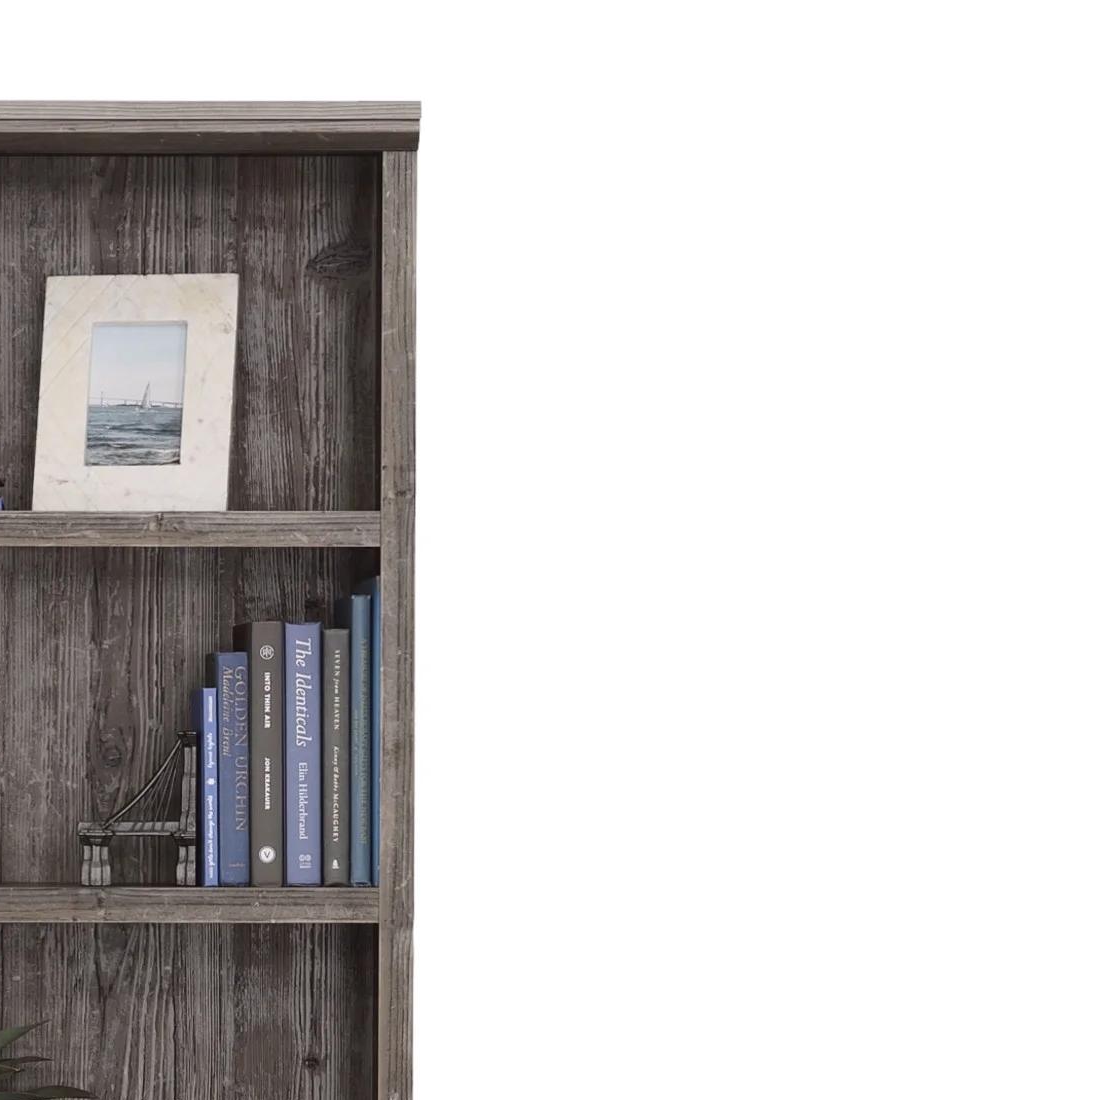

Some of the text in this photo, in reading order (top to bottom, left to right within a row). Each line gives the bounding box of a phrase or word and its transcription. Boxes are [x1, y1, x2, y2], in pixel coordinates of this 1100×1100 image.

[223, 666, 233, 722] Madeleine
[295, 637, 312, 747] The Identicals
[235, 666, 248, 831] GOLDEN URCHIN
[299, 762, 308, 840] Elin Hilderbrand
